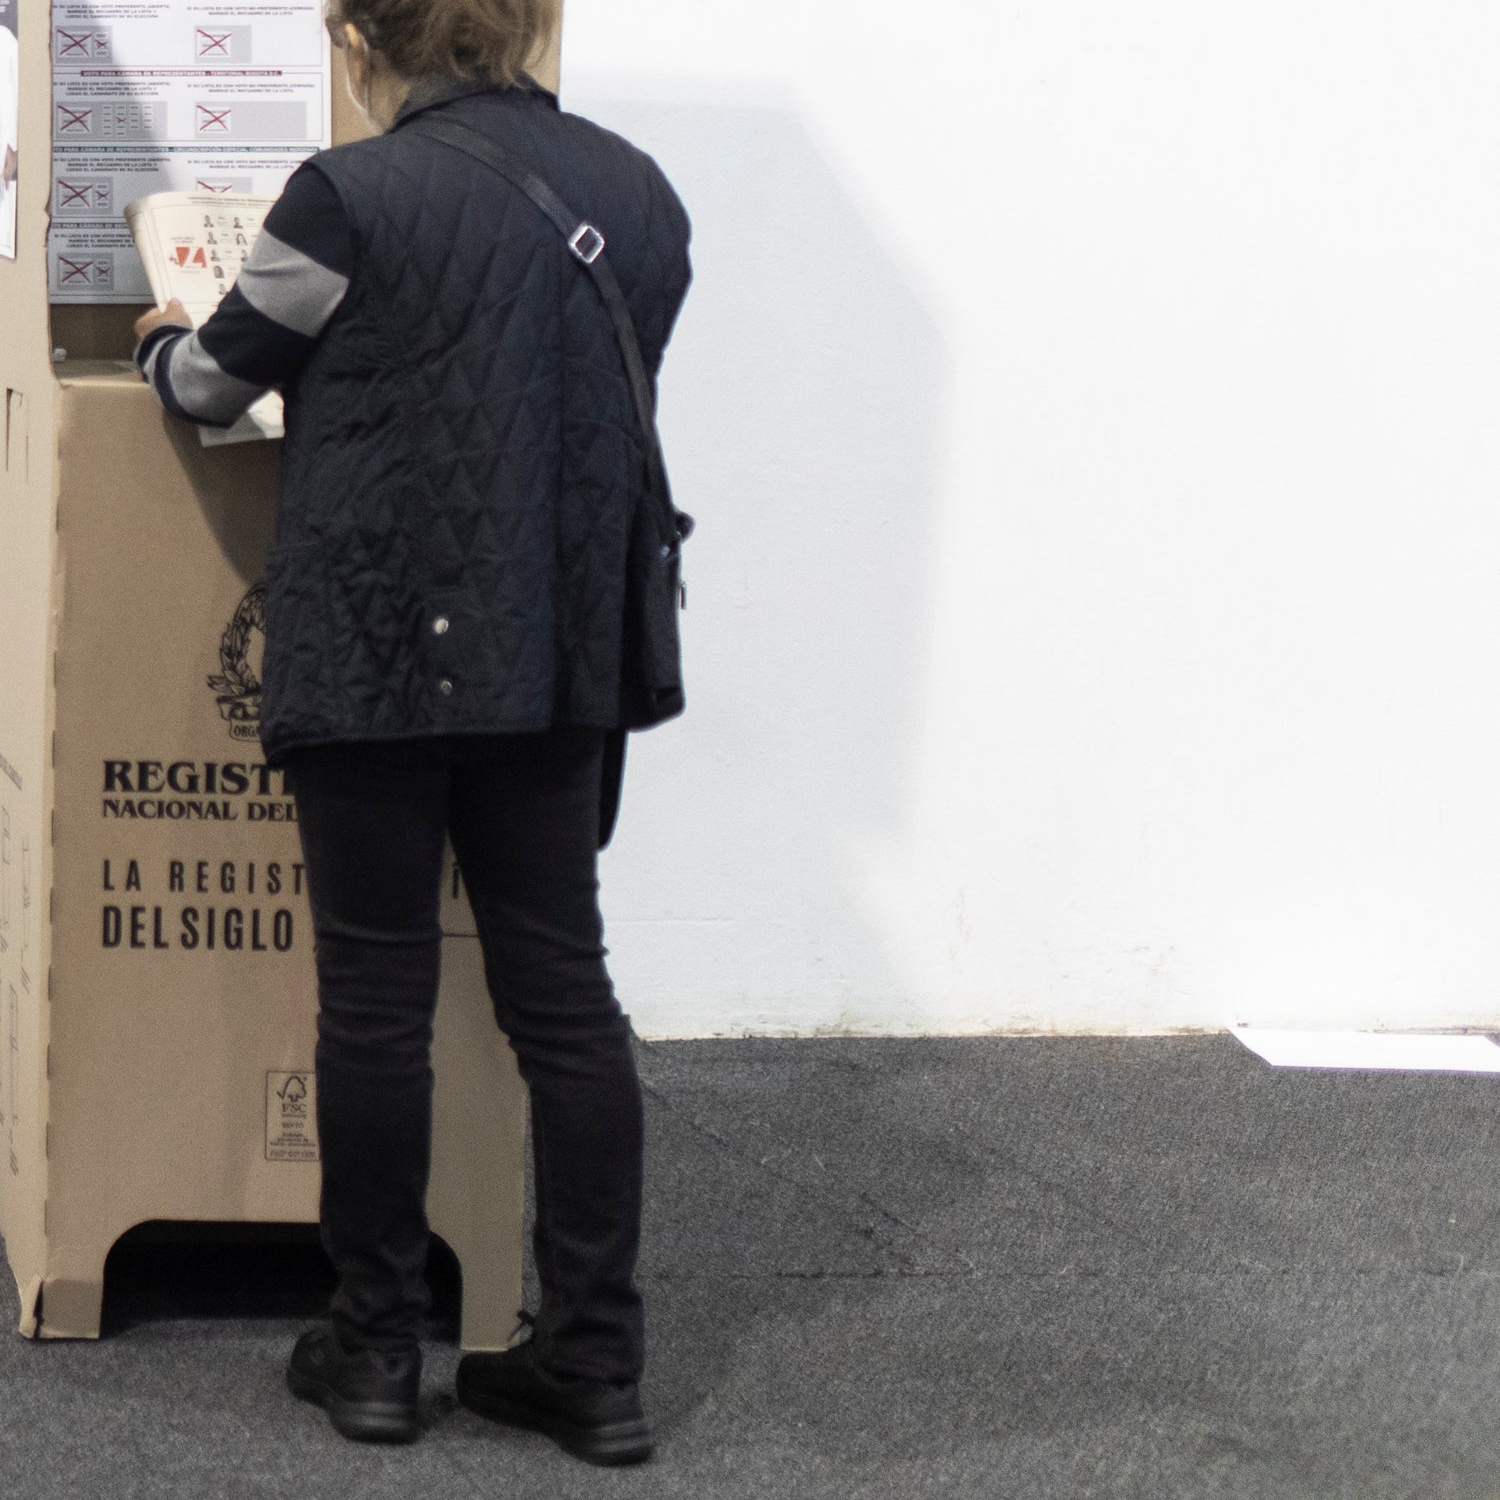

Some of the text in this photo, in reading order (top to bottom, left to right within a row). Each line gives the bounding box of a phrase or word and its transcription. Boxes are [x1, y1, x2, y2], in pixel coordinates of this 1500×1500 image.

[103, 799, 299, 823] NACIONAL DEL
[103, 859, 305, 896] LA REGIST
[281, 1102, 307, 1113] FSC
